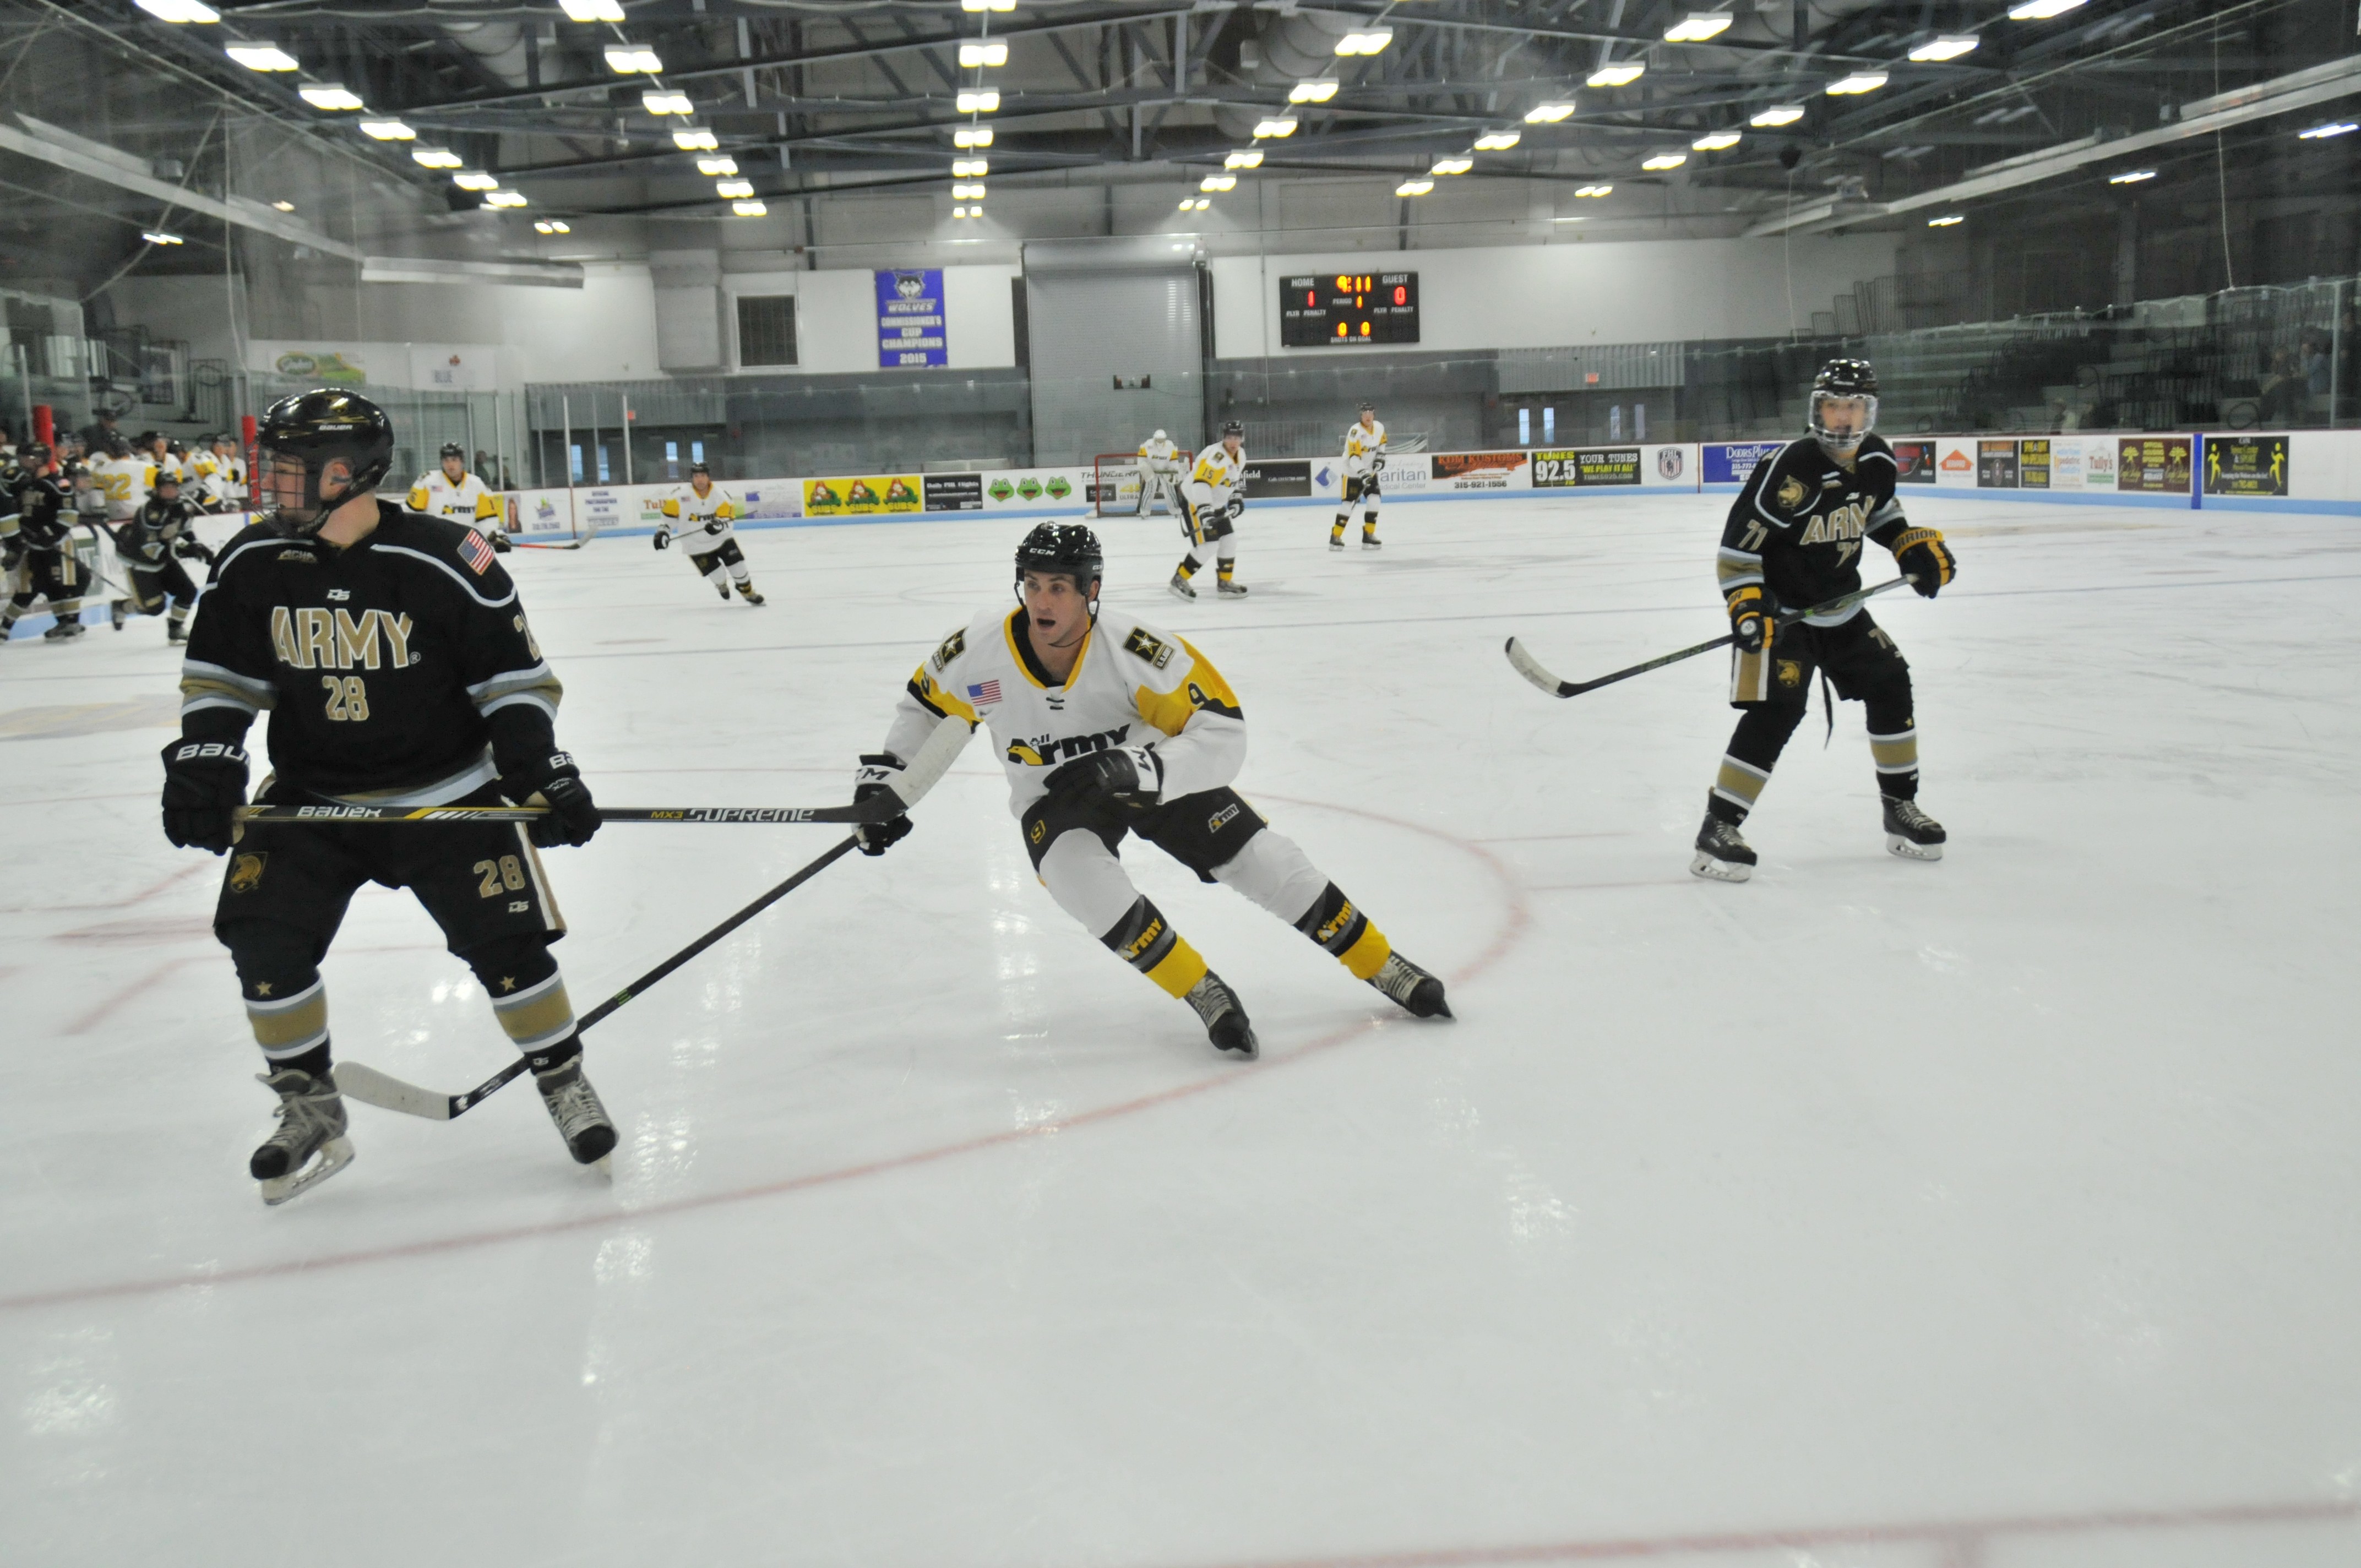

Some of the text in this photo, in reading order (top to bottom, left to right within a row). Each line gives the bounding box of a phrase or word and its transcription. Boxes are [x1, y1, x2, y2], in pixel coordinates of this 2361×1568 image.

[1291, 277, 1314, 287] HOME
[1336, 275, 1372, 293] 9:11
[1383, 274, 1408, 284] GUEST
[1307, 291, 1315, 307] 1
[1356, 295, 1363, 308] 1
[1394, 286, 1406, 306] 0
[888, 304, 933, 312] WOLVES
[901, 327, 922, 337] CUP
[1337, 322, 1370, 336] 0 0
[882, 337, 943, 350] CHAMPIONS
[1468, 453, 1522, 463] KUSTOMS
[1536, 451, 1575, 460] TUNES
[1580, 453, 1638, 463] YOUR TUNES
[1662, 449, 1679, 458] FHL
[2089, 453, 2113, 472] Tully's
[1202, 467, 1215, 479] 15
[1380, 469, 1427, 482] aritan
[1536, 460, 1576, 482] 92.5
[271, 606, 414, 669] ARMY
[322, 676, 369, 721] 28
[176, 743, 251, 765] BAU
[297, 806, 383, 818] BAUER
[650, 808, 816, 823] MX3 SUPREME
[1031, 819, 1046, 843] 9
[473, 854, 526, 898] 28
